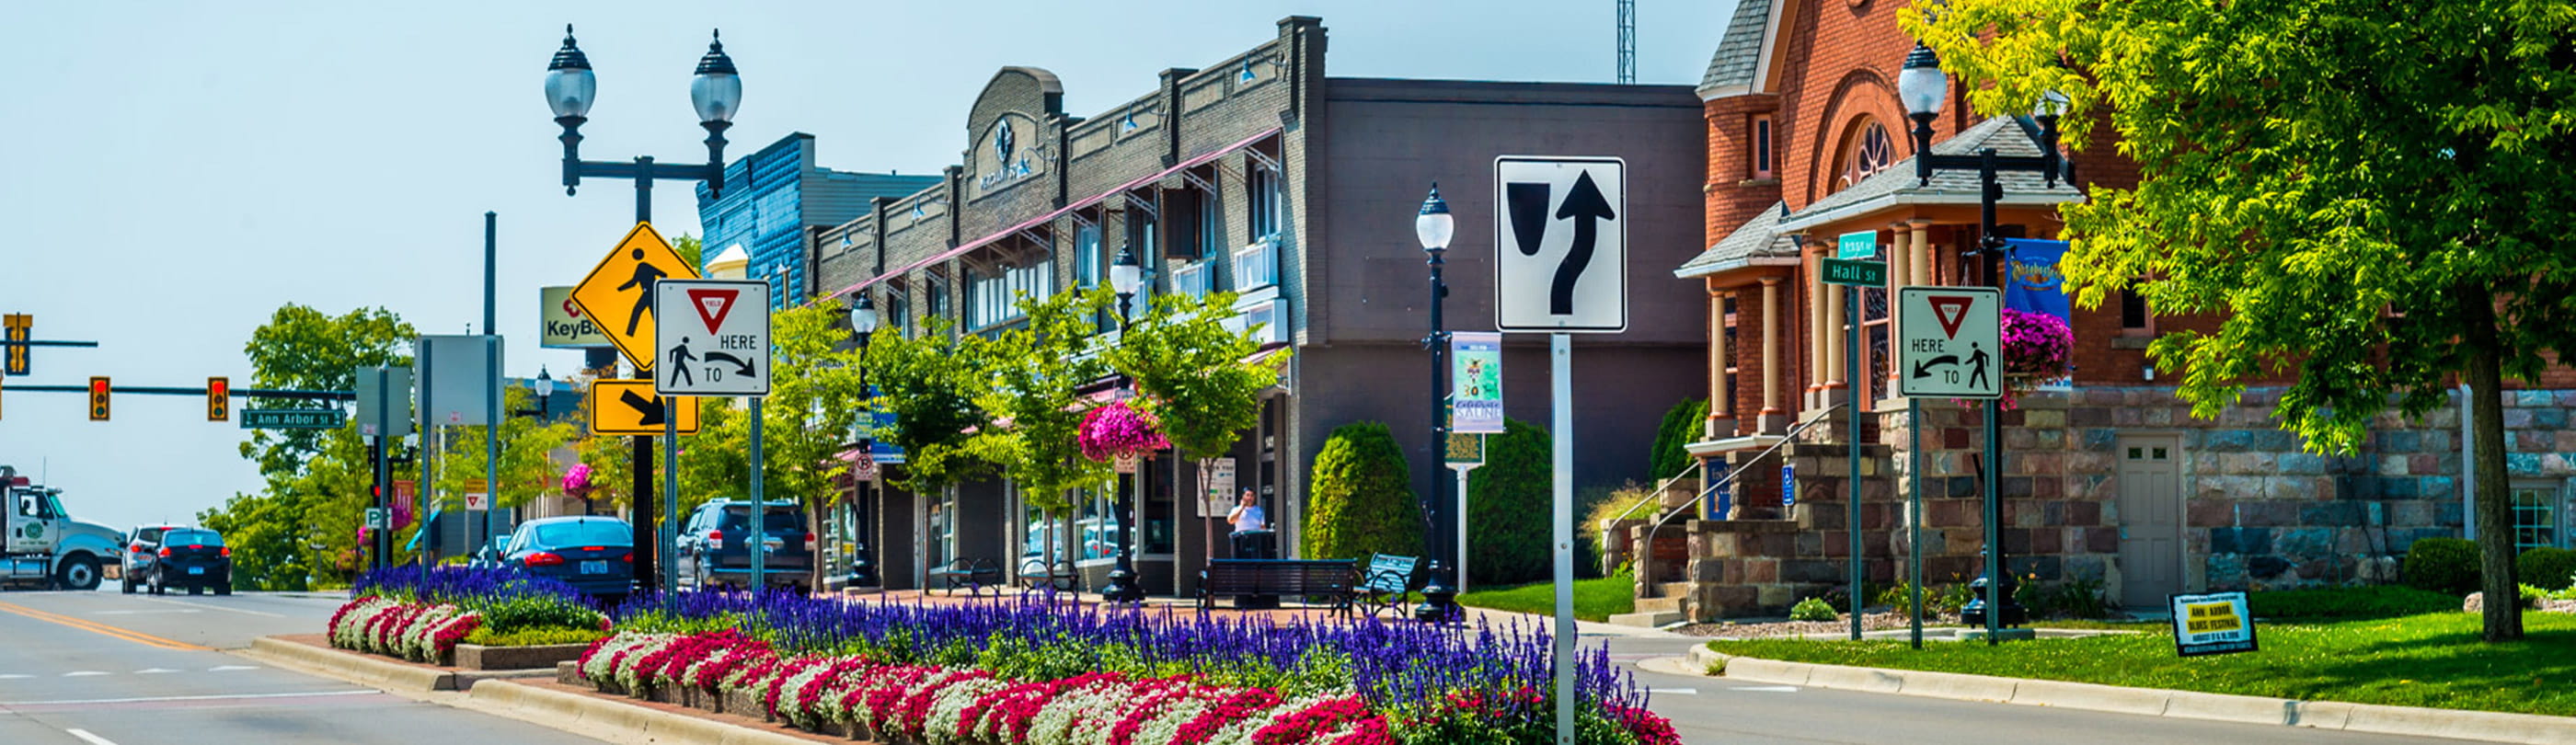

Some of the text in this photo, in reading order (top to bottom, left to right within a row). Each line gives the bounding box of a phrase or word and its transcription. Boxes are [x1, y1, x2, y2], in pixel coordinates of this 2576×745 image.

[1833, 264, 1860, 281] Hall
[547, 320, 604, 339] KeyBa
[720, 335, 757, 350] HERE
[1912, 338, 1945, 353] HERE
[705, 367, 722, 383] TO
[1944, 370, 1960, 384] TO
[258, 414, 279, 424] Ann
[283, 414, 315, 424] Arbor
[2191, 607, 2205, 616] ANN
